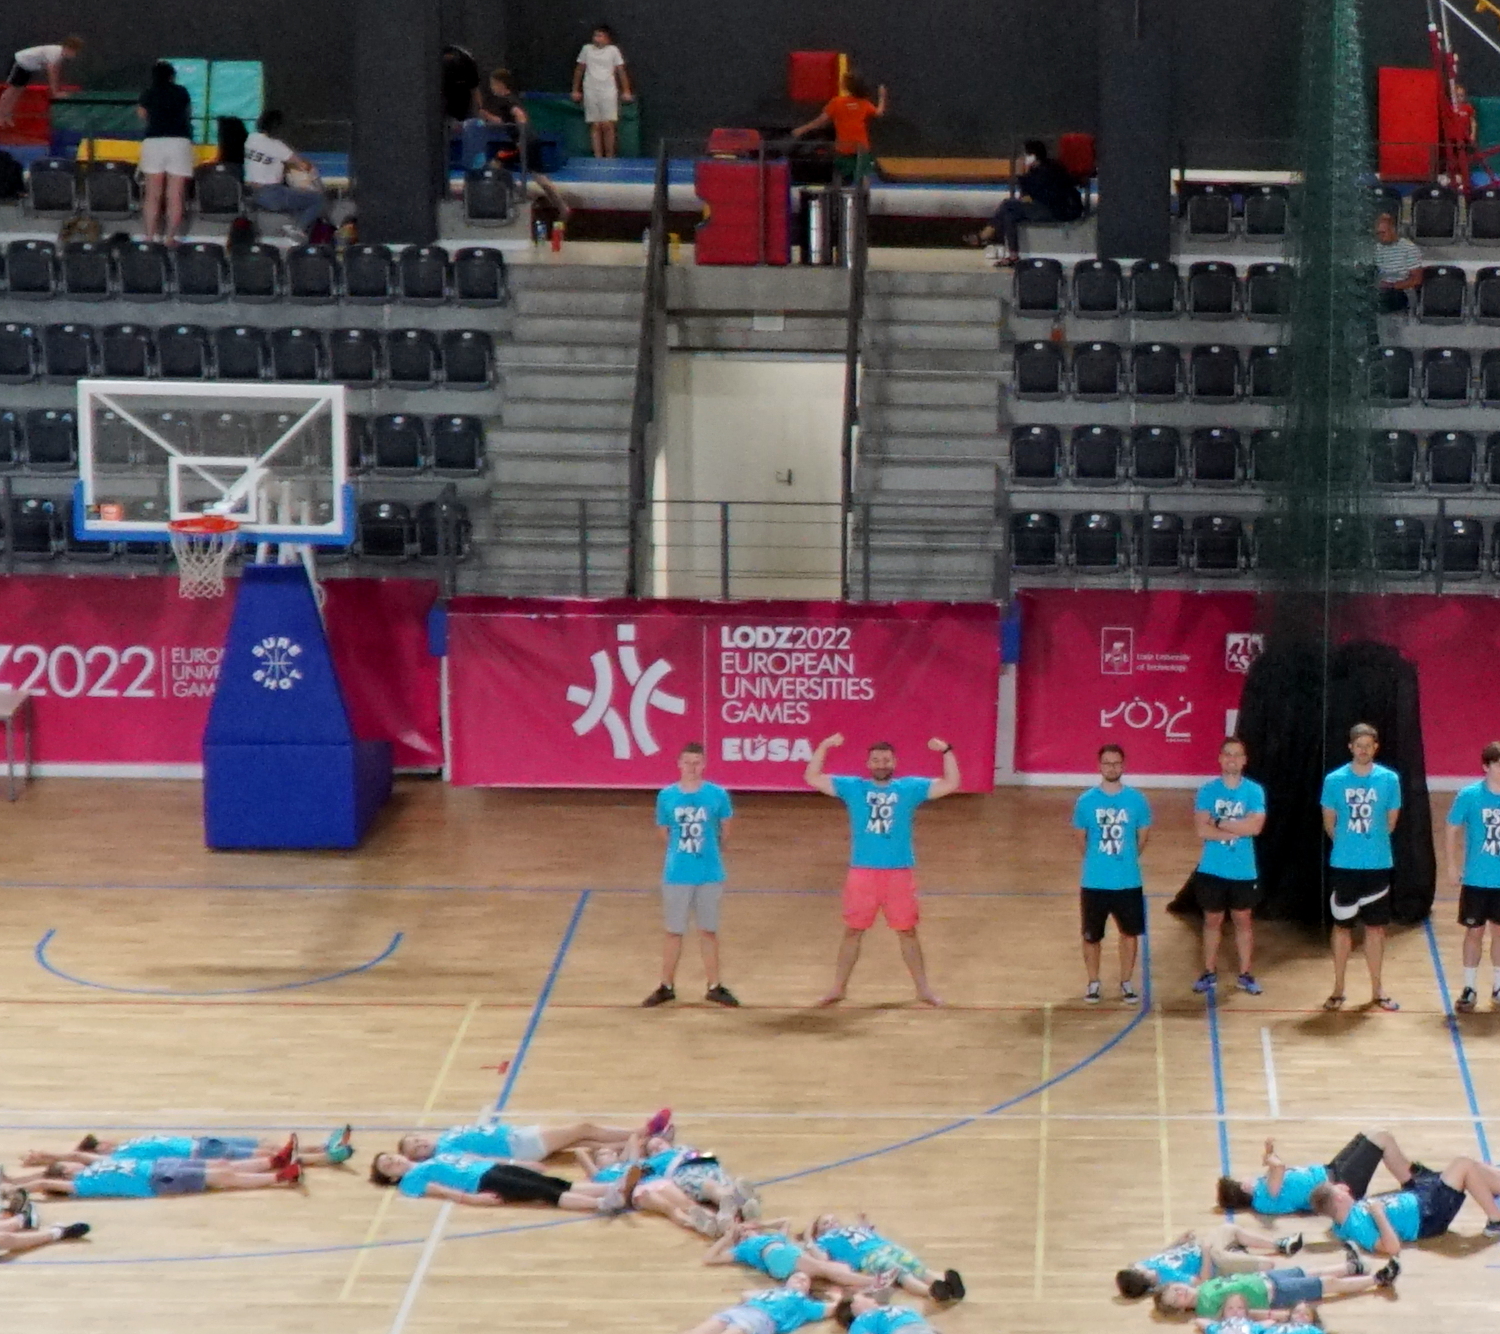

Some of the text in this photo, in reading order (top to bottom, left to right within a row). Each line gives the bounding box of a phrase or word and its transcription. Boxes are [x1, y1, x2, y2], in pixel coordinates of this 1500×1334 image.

[720, 625, 851, 650] LODZ2022
[251, 636, 302, 657] SURE
[720, 652, 855, 675] EUROPEAN
[252, 669, 303, 690] SHOT
[720, 676, 875, 701] UNIVERSITIES
[721, 700, 812, 725] GAMES
[721, 736, 813, 763] EUSA
[865, 791, 898, 805] PSA
[1344, 787, 1378, 804] PSA
[674, 805, 707, 823] PSA
[869, 805, 894, 819] TO
[1095, 807, 1129, 824] PSA
[1214, 799, 1244, 816] PSA
[1349, 803, 1372, 818] TO
[679, 822, 703, 838] TO
[865, 818, 894, 835] MY
[1100, 824, 1123, 839] TO
[1347, 818, 1373, 834] MY
[677, 838, 704, 854] MY
[1098, 839, 1124, 855] MY
